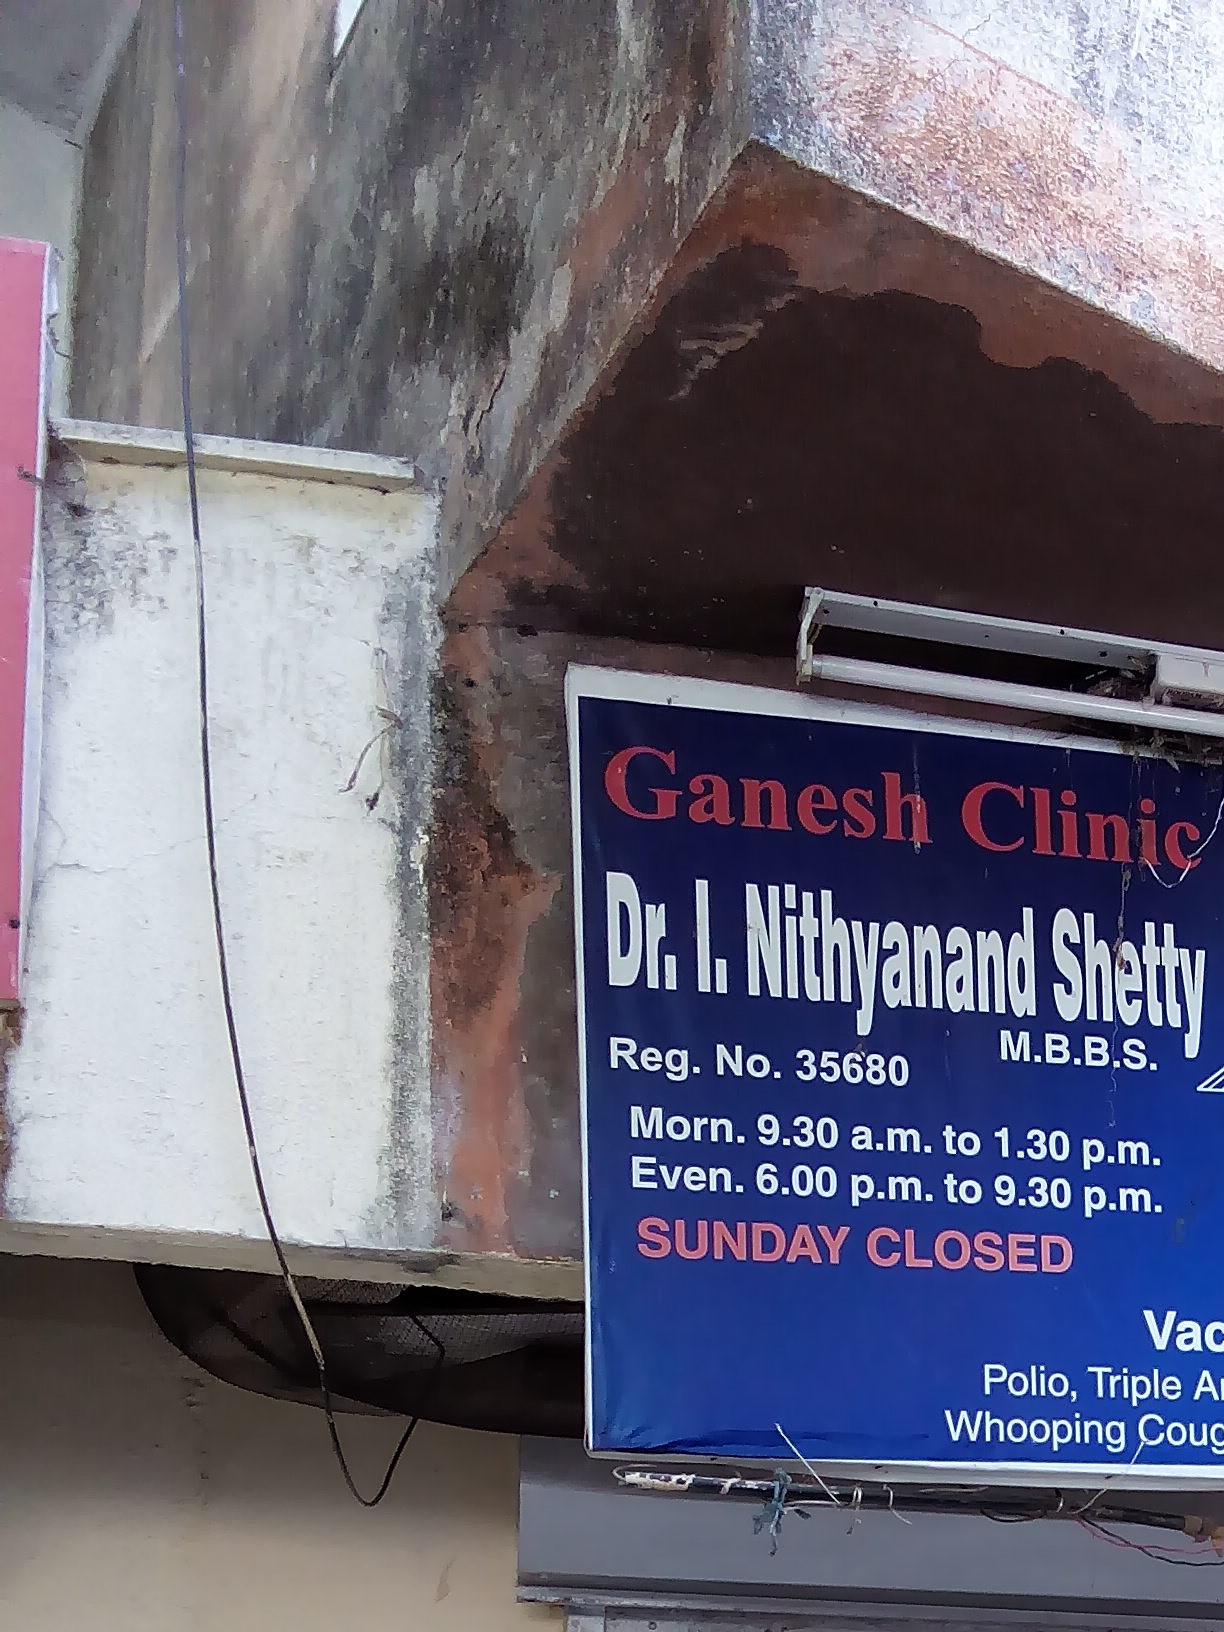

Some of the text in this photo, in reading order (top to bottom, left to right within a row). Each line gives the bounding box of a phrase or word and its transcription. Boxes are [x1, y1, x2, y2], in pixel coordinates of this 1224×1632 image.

[604, 745, 1202, 869] Ganesh Clinic
[606, 871, 1206, 1059] Dr. I. Nithyanand Shetty
[610, 1036, 909, 1087] Reg. No. 35680
[1000, 1029, 1158, 1071] M.B.B.S.
[630, 1106, 1161, 1176] Morn. 9.30 a.m. to 1.30 p.m.
[632, 1157, 1163, 1223] Even. 6.00 p.m. to 9.30 p.m.
[637, 1217, 1073, 1274] SUNDAY CLOSED
[983, 1364, 1078, 1404] Polio,
[1088, 1366, 1183, 1406] Triple
[944, 1410, 1126, 1454] Whooping
